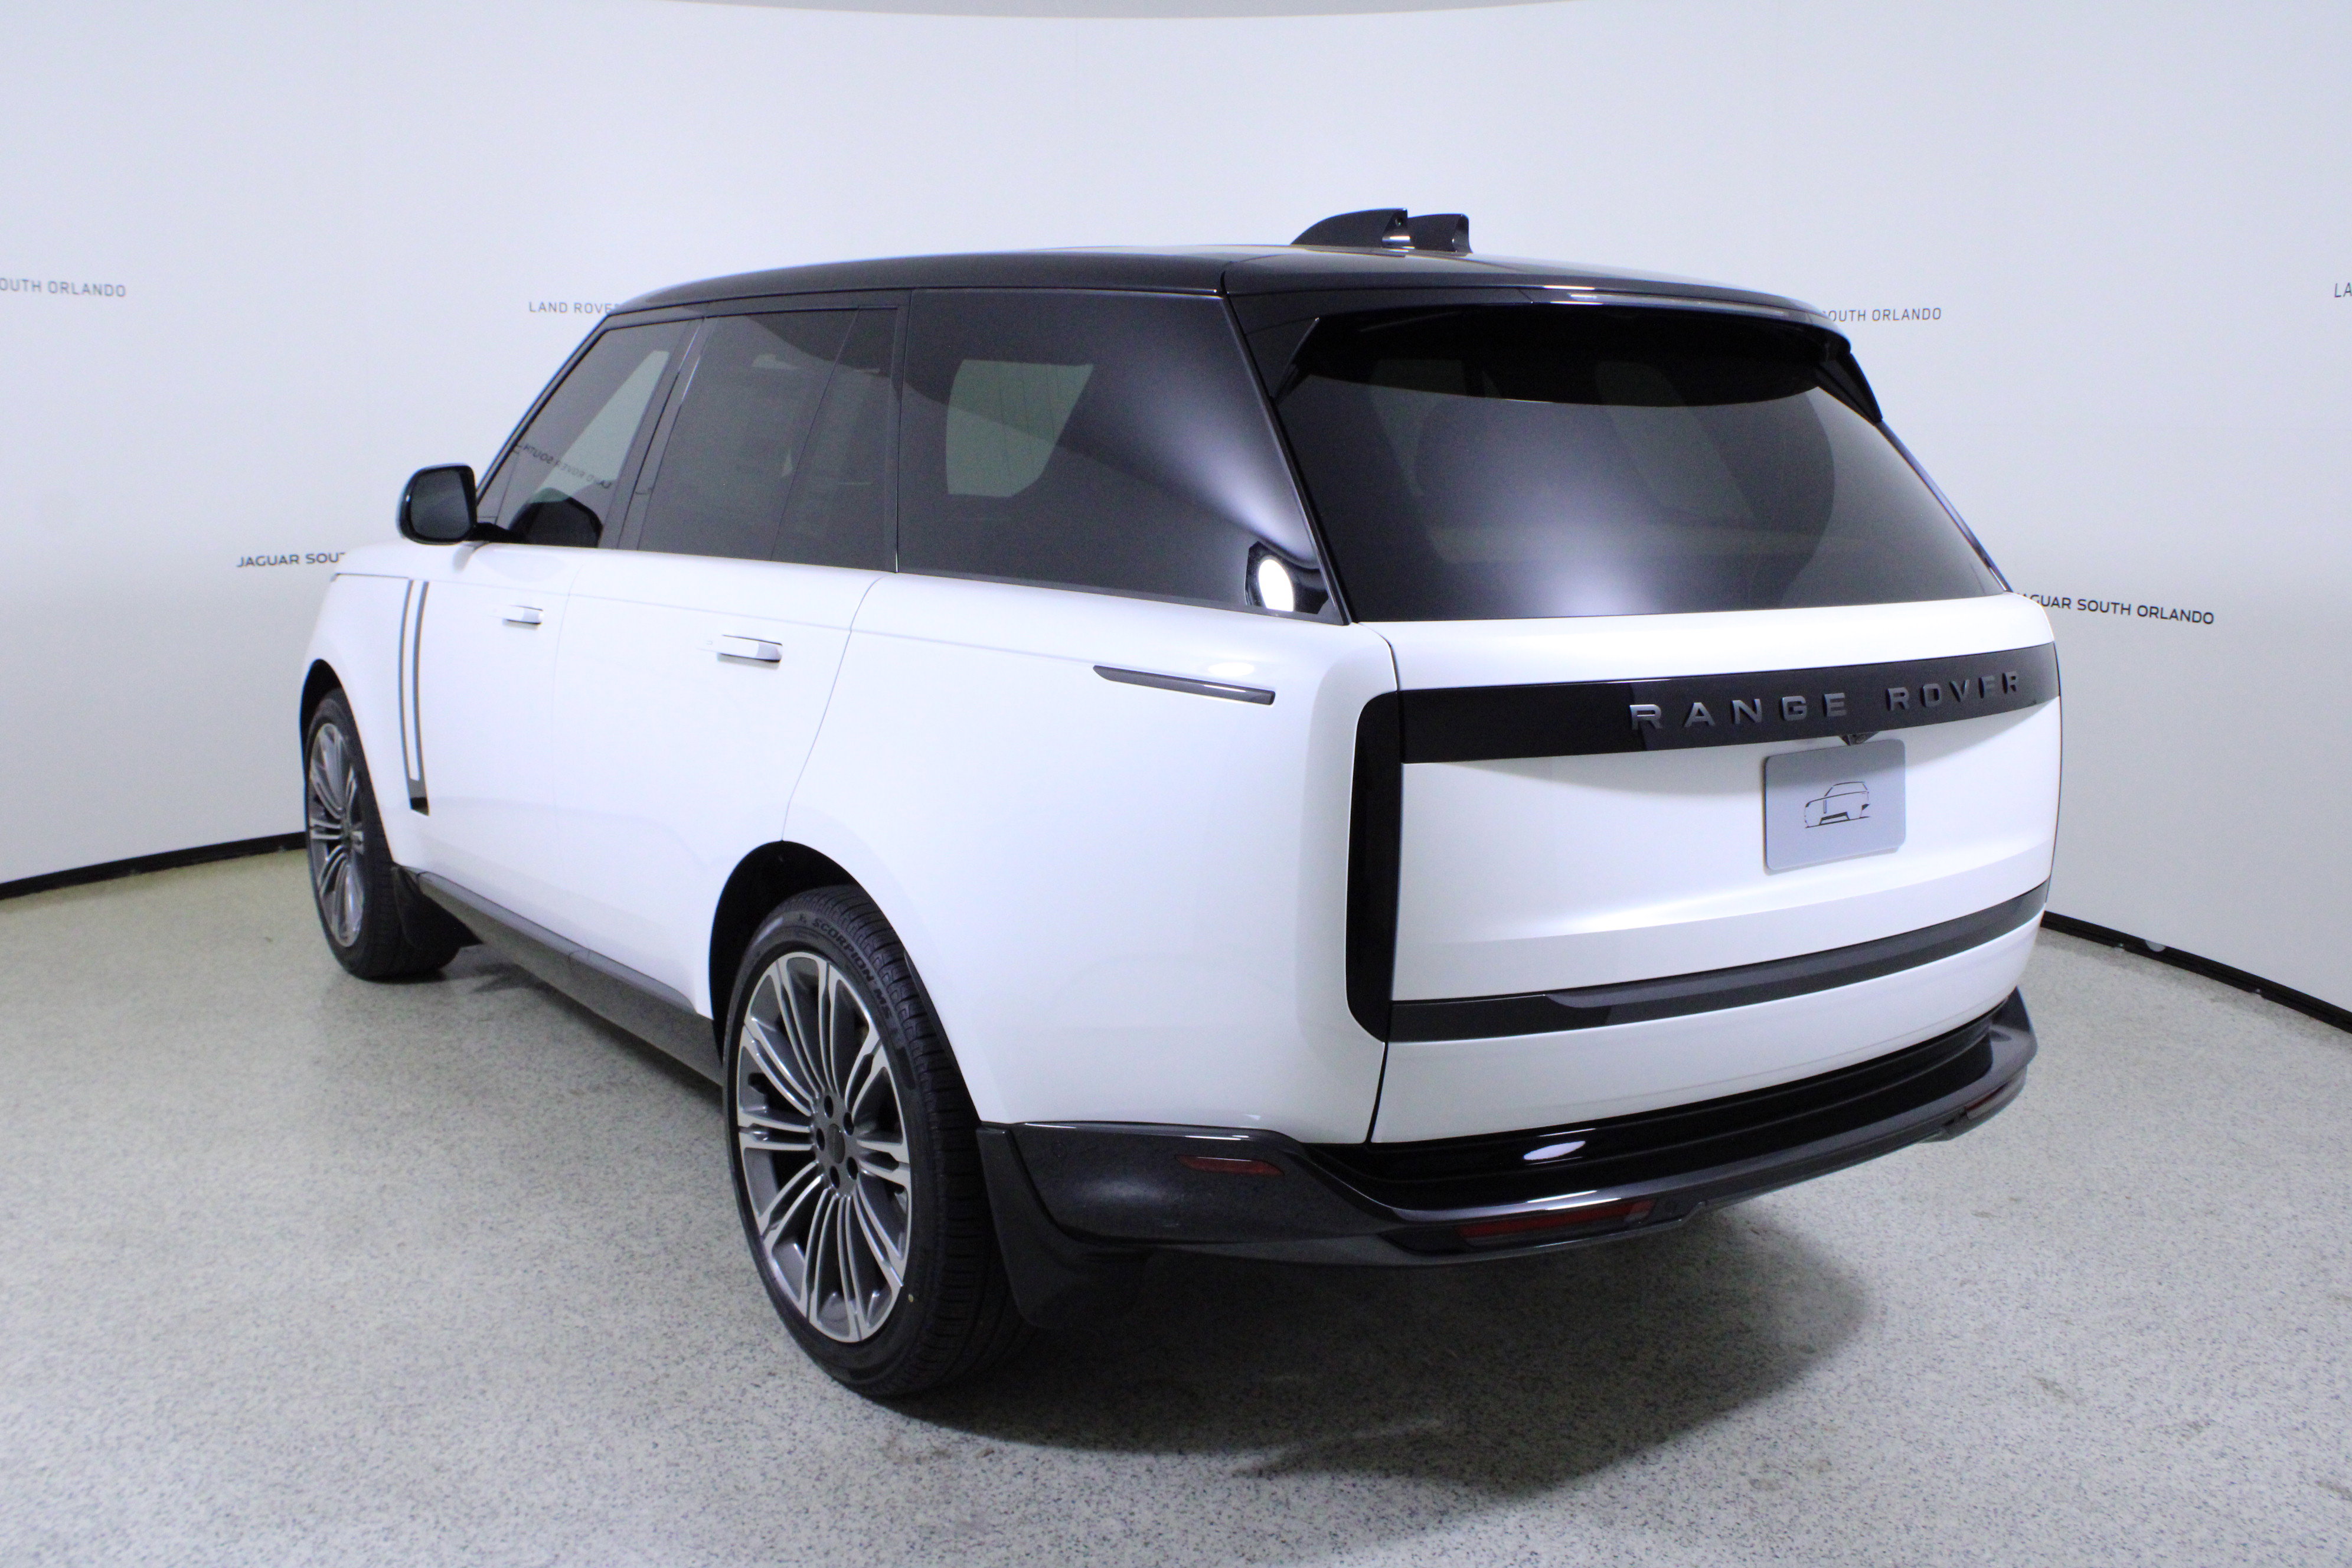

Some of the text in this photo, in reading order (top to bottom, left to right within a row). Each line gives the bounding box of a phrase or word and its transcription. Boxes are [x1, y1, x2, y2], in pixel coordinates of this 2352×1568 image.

[47, 280, 127, 297] ORLANDO
[528, 301, 568, 313] LAND
[1823, 307, 1942, 322] OUTH ORLANDO
[237, 554, 300, 568] JAGUAR
[2077, 599, 2131, 616] SOUTH
[2137, 605, 2214, 625] ORLANDO
[1629, 671, 2020, 731] RANGE ROVER
[812, 917, 875, 982] SCORPION
